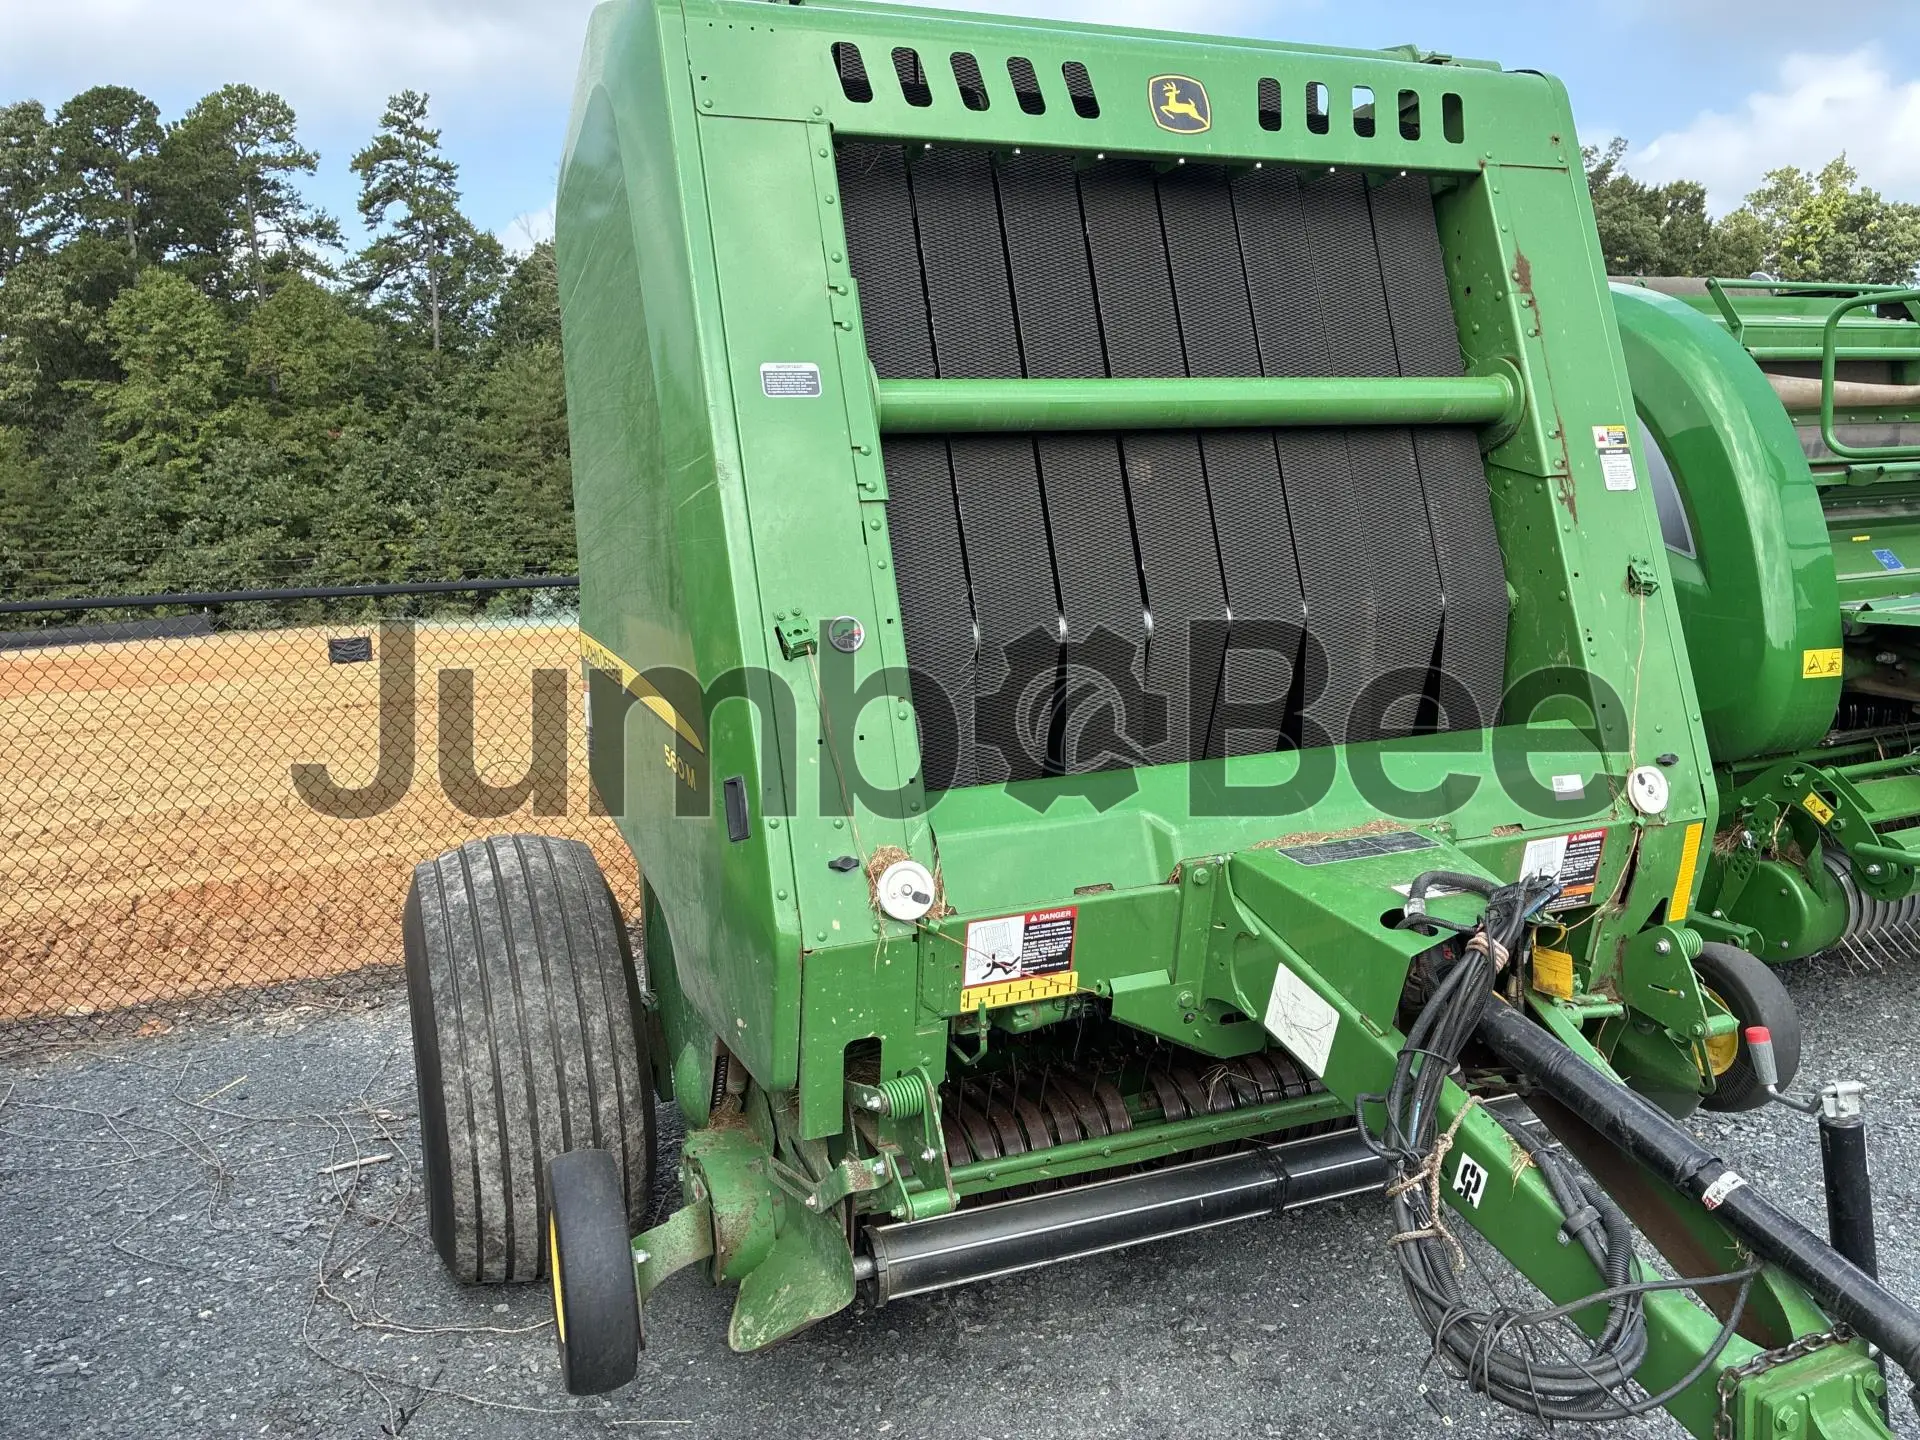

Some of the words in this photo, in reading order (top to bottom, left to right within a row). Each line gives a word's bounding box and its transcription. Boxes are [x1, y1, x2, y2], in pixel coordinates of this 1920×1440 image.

[664, 743, 697, 792] 560M
[1578, 831, 1603, 840] DANGER
[1040, 910, 1072, 920] DANGER
